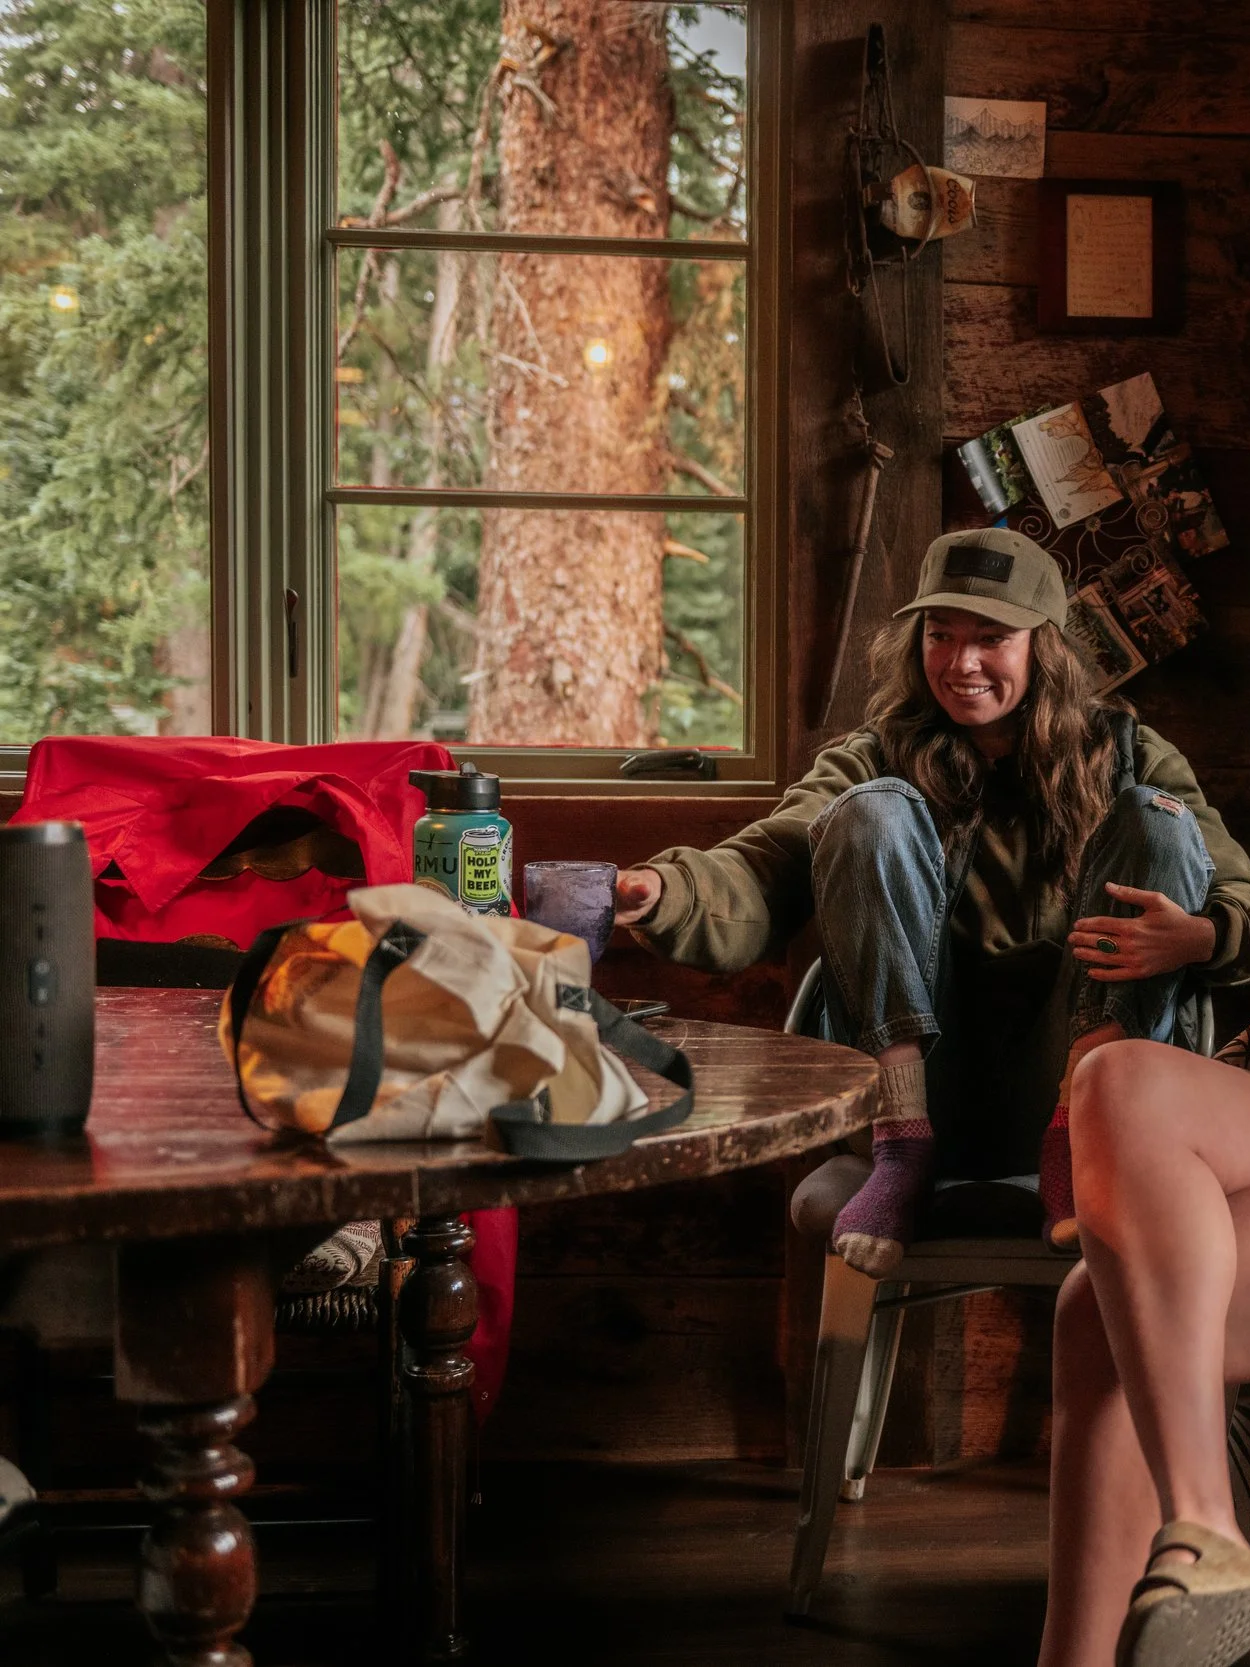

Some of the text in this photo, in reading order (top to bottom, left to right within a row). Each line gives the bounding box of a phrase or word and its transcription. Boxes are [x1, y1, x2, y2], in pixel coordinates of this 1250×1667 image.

[946, 178, 962, 224] Coors
[415, 854, 458, 876] RMU
[467, 856, 497, 867] HOLD
[474, 869, 491, 879] MY
[467, 879, 497, 891] BEER
